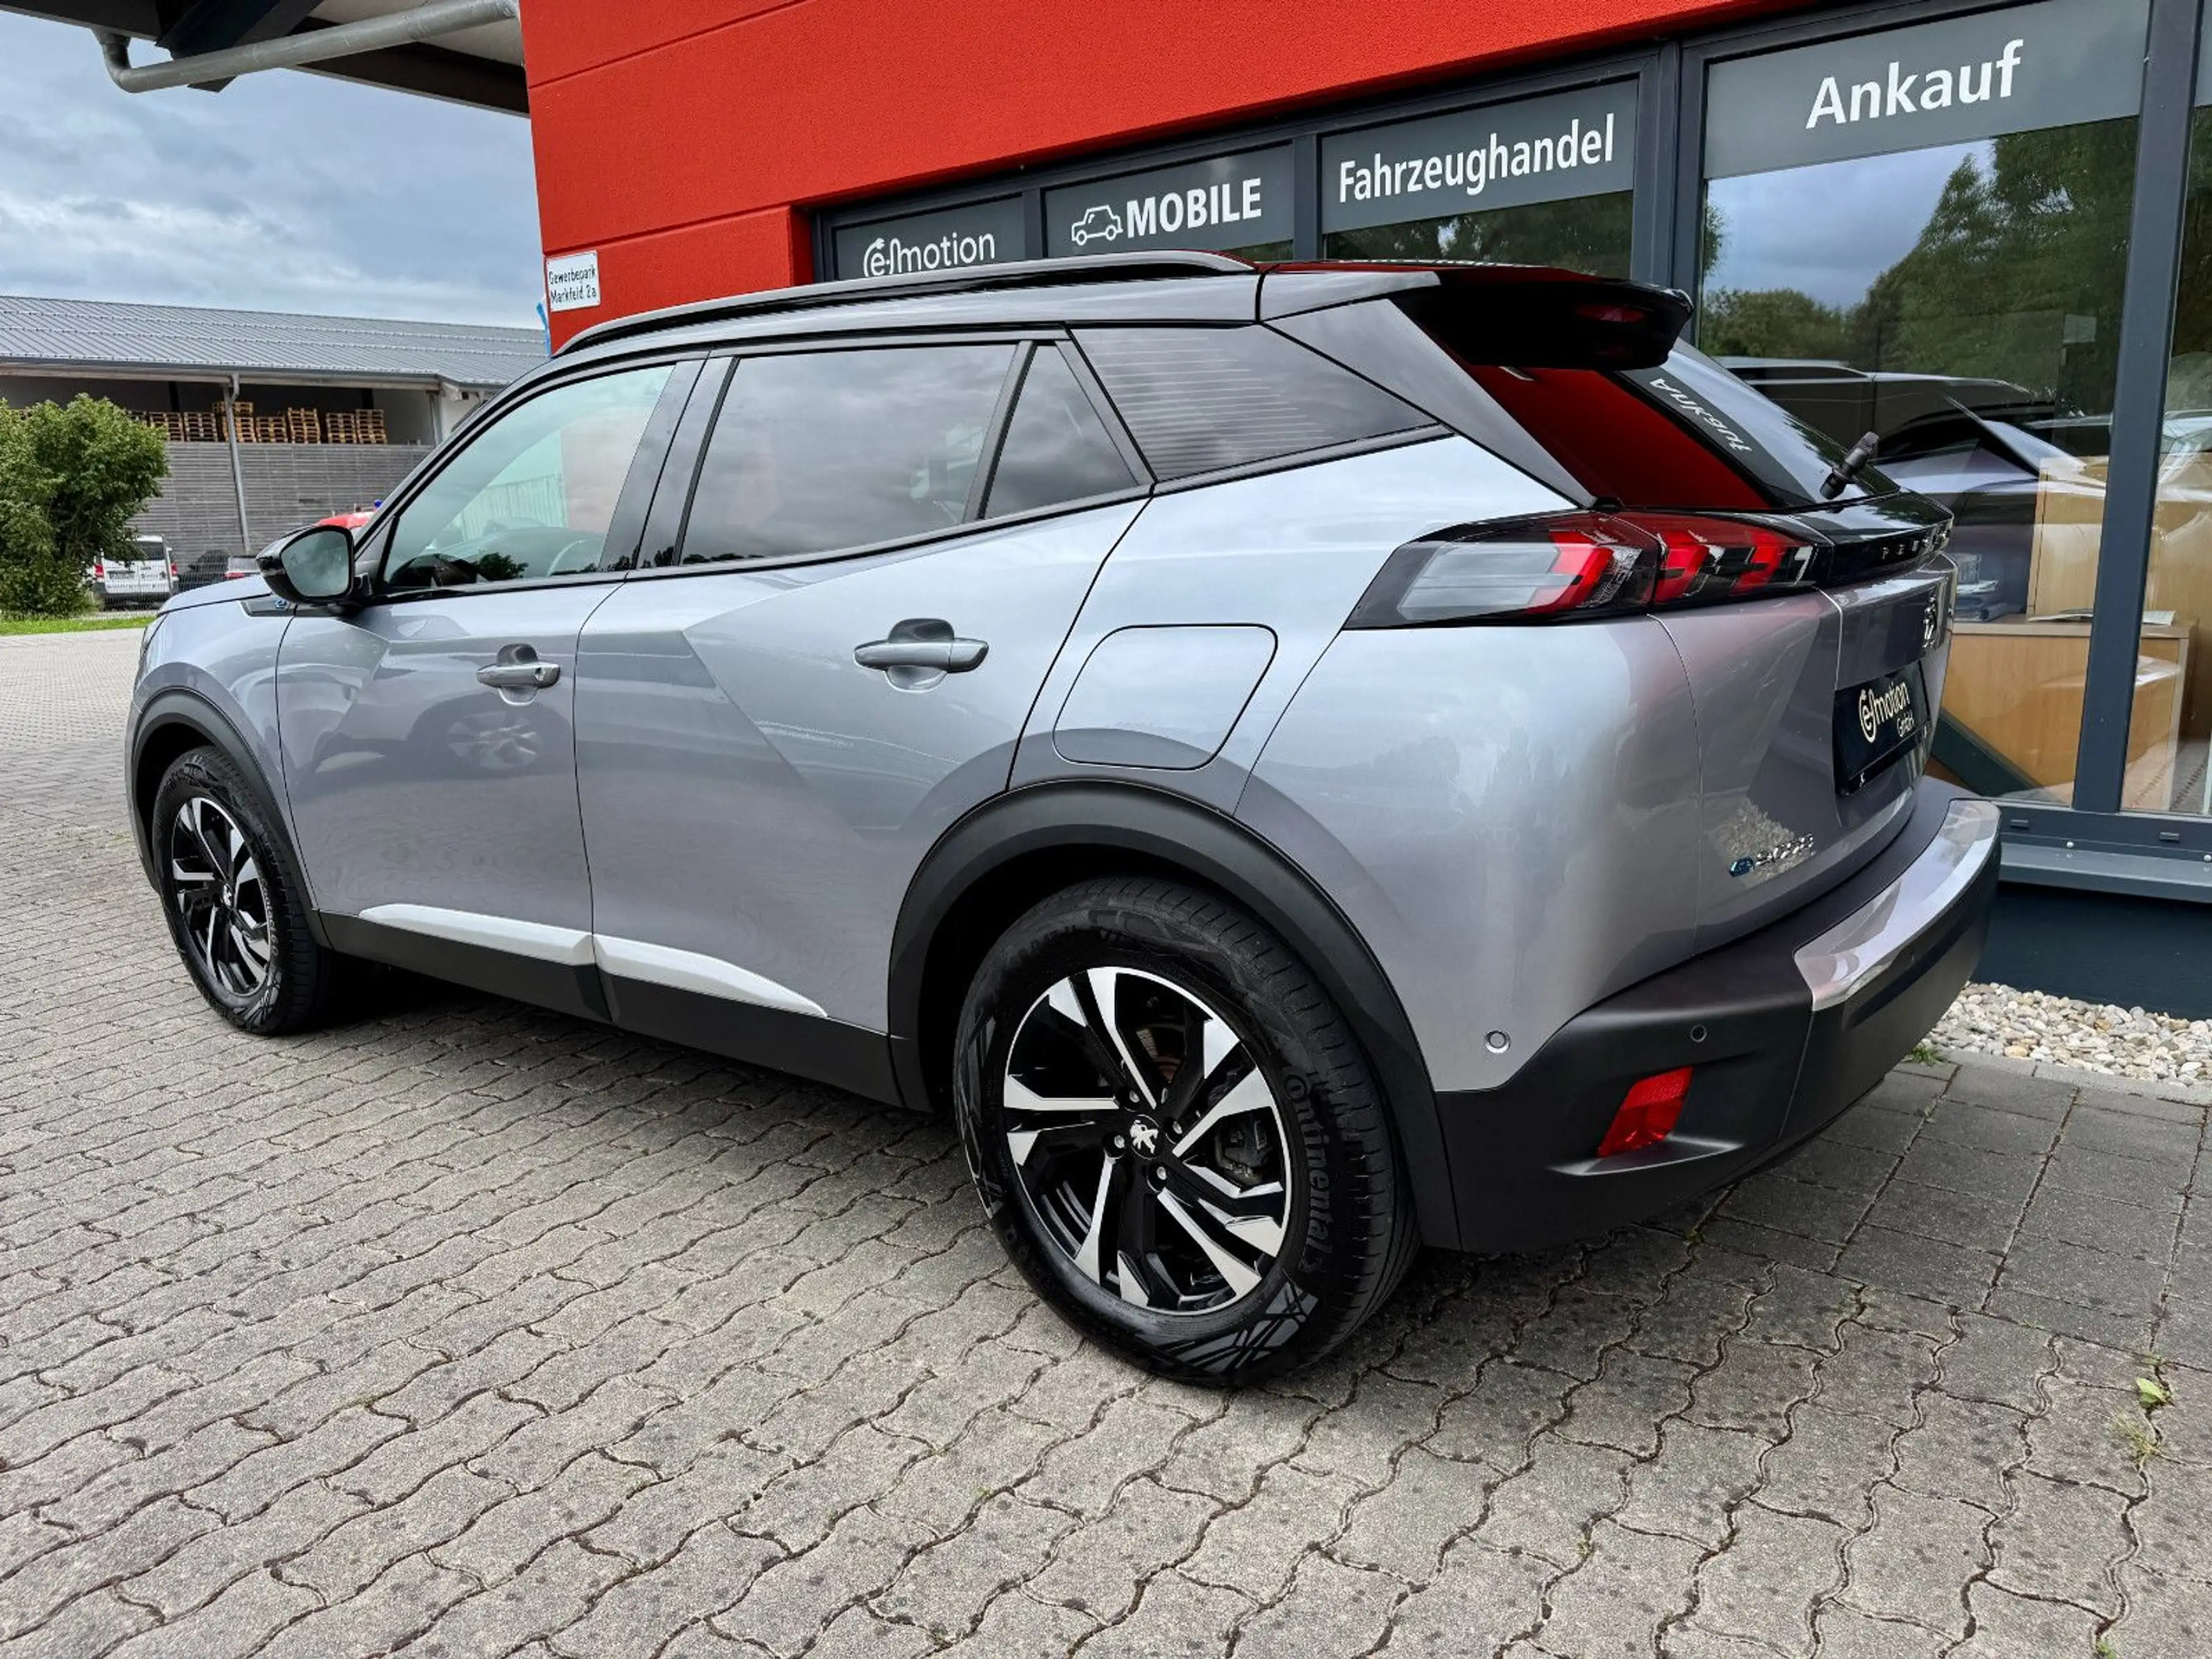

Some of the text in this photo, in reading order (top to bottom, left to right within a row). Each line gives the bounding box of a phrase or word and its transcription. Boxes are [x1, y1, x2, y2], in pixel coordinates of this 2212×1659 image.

[1805, 39, 2024, 129] Ankauf
[1339, 113, 1615, 203] Fahrzeughandel
[1127, 177, 1262, 238] MOBILE
[548, 264, 596, 285] Gewerbepark
[550, 284, 597, 304] Markfeld 2a
